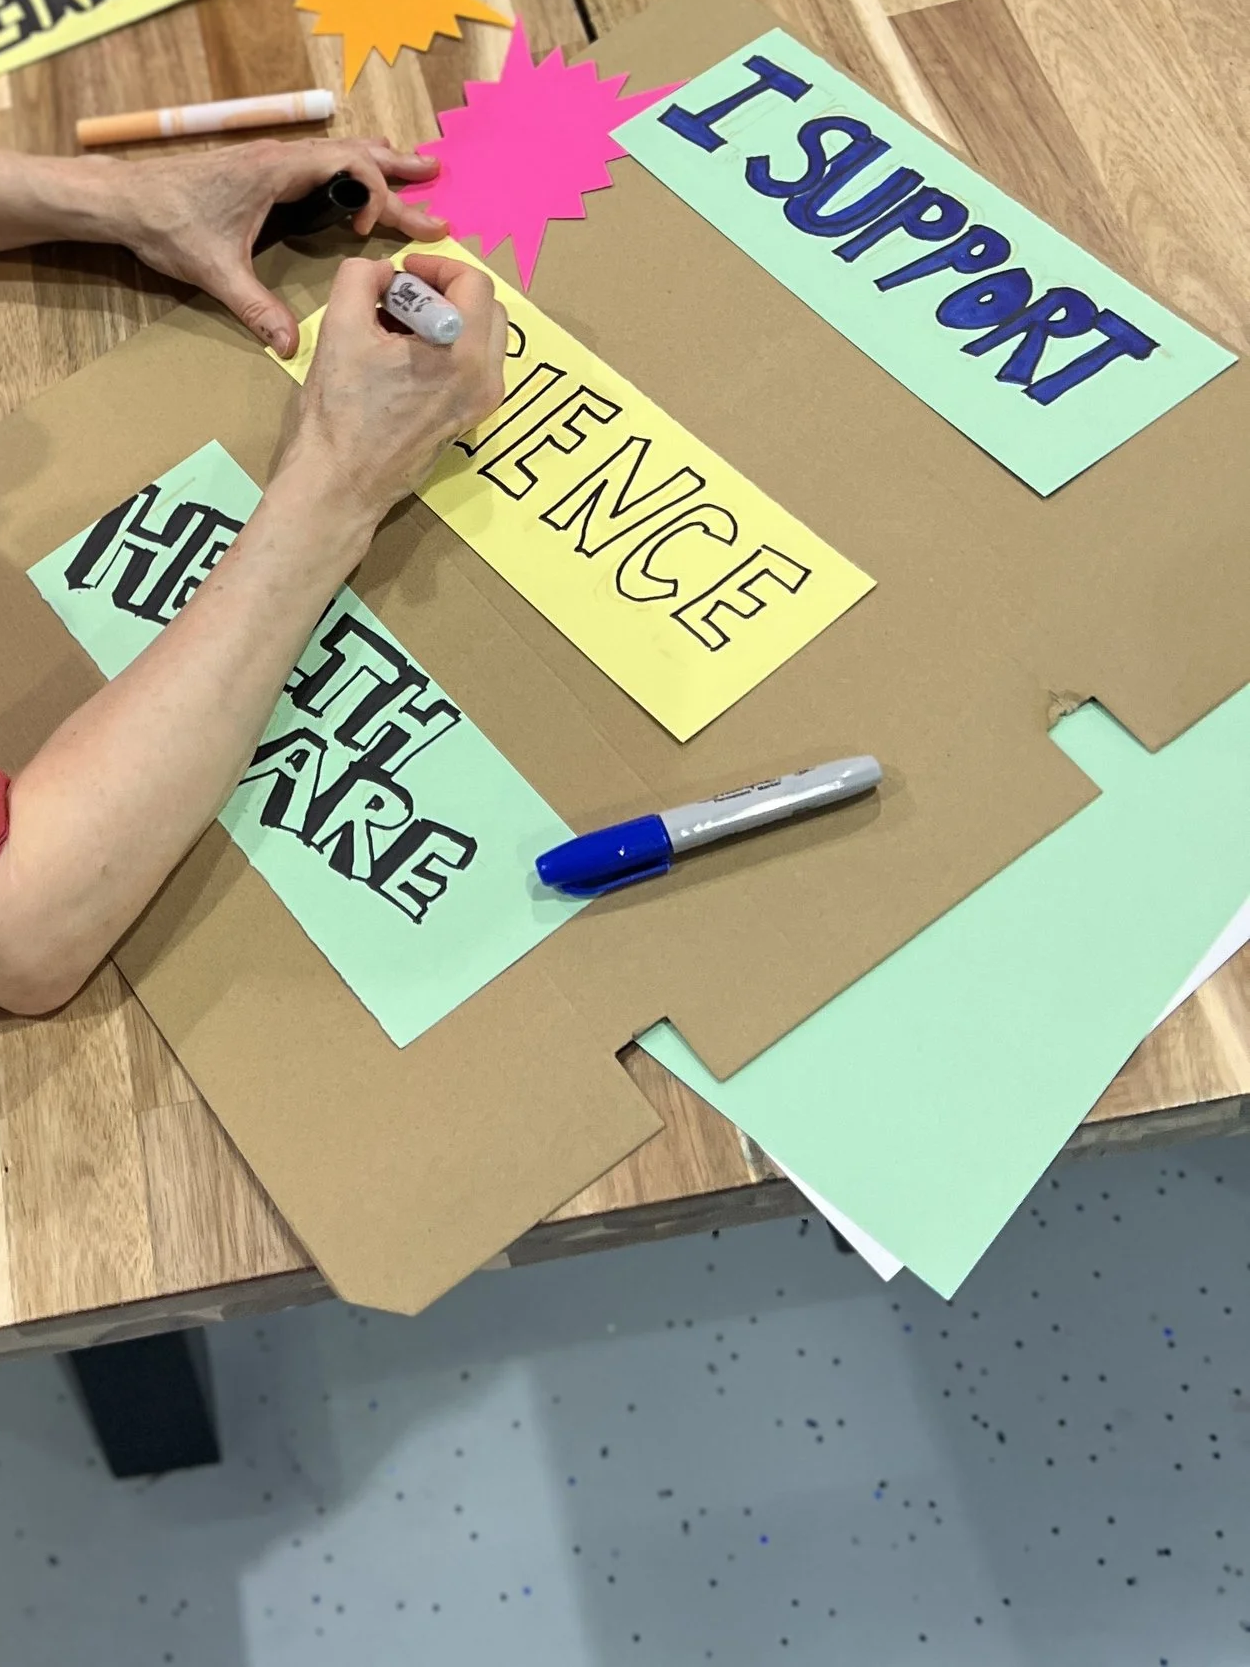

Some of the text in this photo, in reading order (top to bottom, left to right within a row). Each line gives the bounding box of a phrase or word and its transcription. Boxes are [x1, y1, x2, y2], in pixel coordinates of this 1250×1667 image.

[657, 54, 1162, 407] I SUPPORT
[63, 483, 462, 778] HETH
[454, 320, 813, 653] IENCE
[238, 726, 478, 925] ARE
